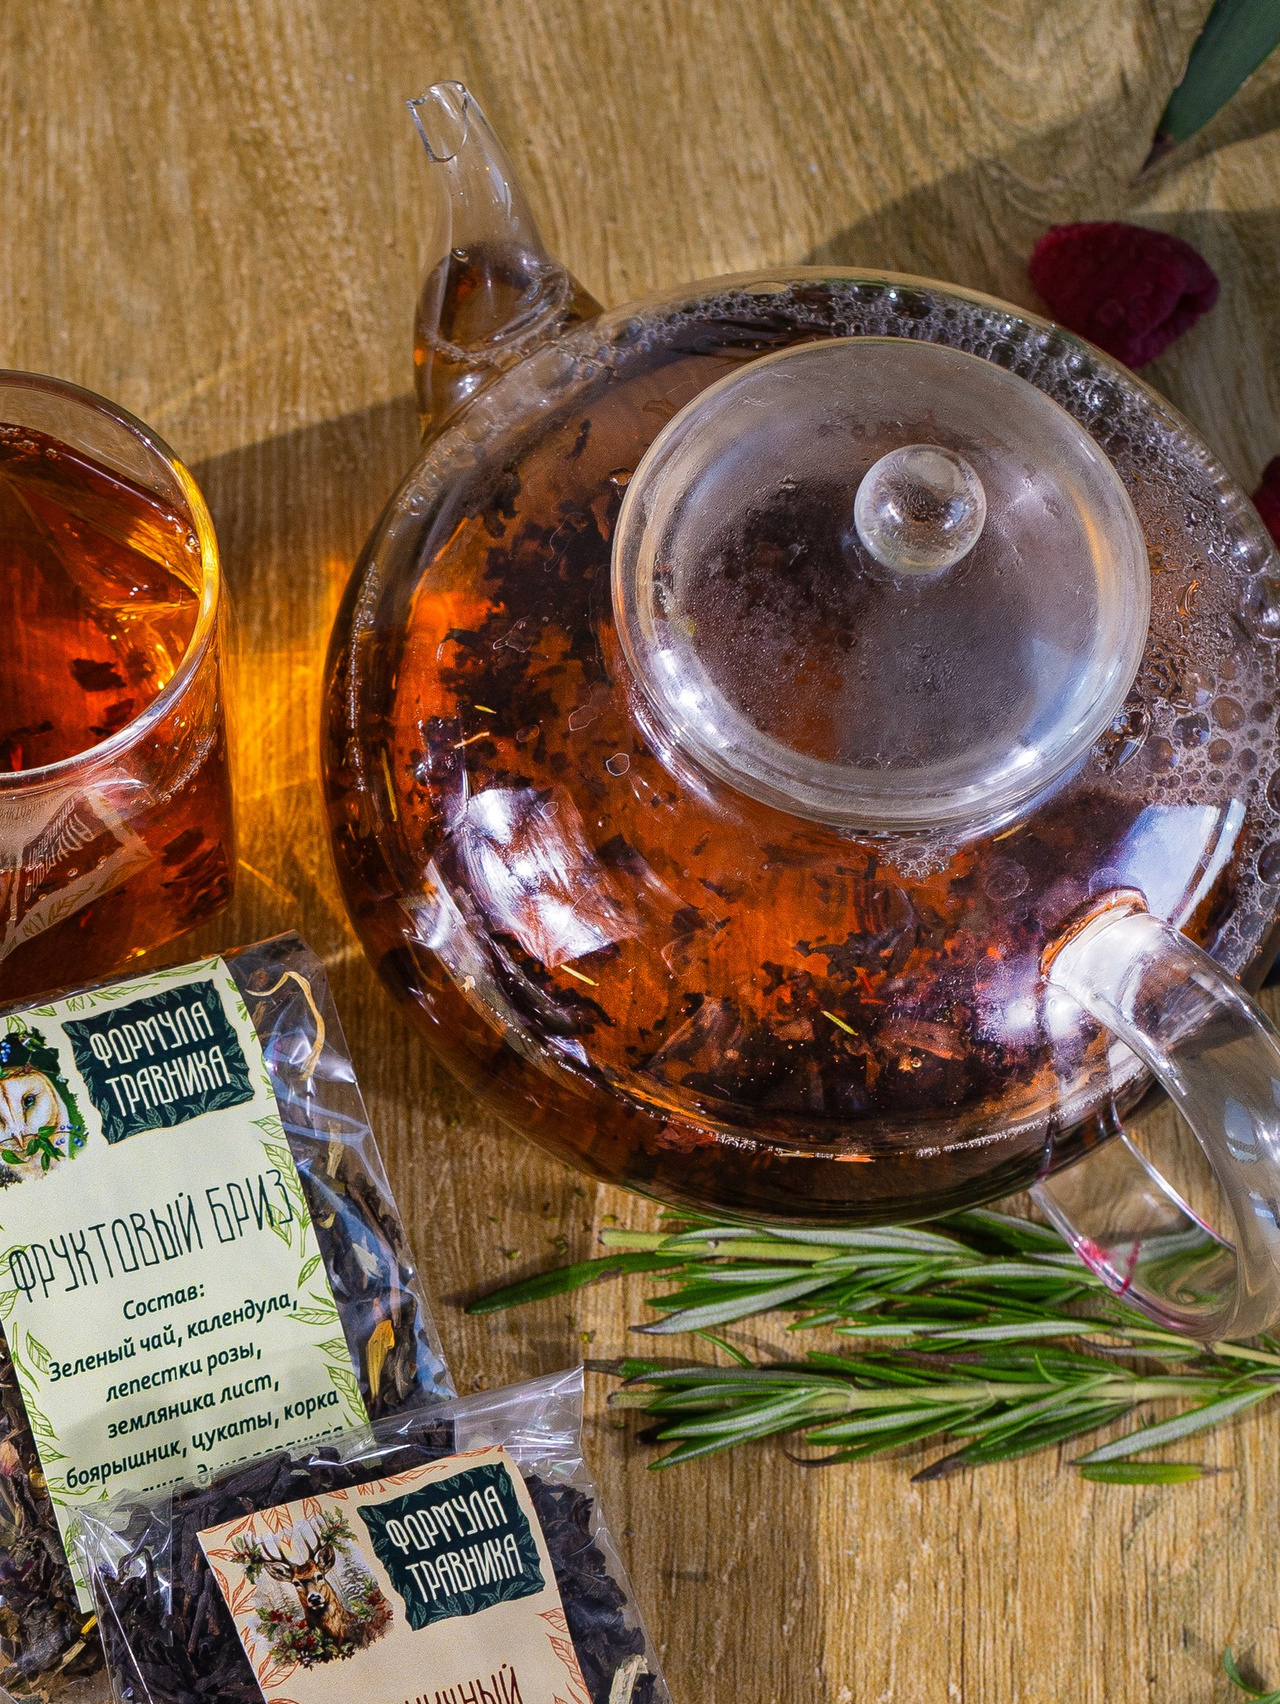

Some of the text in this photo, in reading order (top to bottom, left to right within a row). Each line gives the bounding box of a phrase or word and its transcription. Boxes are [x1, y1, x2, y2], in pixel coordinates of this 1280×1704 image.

[89, 1001, 214, 1068] ФОРМУЛА
[105, 1045, 232, 1117] ТРАВНИКА
[8, 1169, 294, 1302] ФРУКТОВЫЙ БРИЗ
[122, 1283, 206, 1320] Состав:
[48, 1293, 298, 1382] Зеленый чай, календула,
[106, 1342, 262, 1403] лепестки розы,
[66, 1439, 188, 1490] боярышник,
[191, 1411, 280, 1453] цукаты,
[283, 1389, 340, 1421] корка
[107, 1373, 280, 1440] земляника лист,
[385, 1486, 508, 1556] ФОРМУЛА
[405, 1533, 524, 1603] ТРАВНИКА
